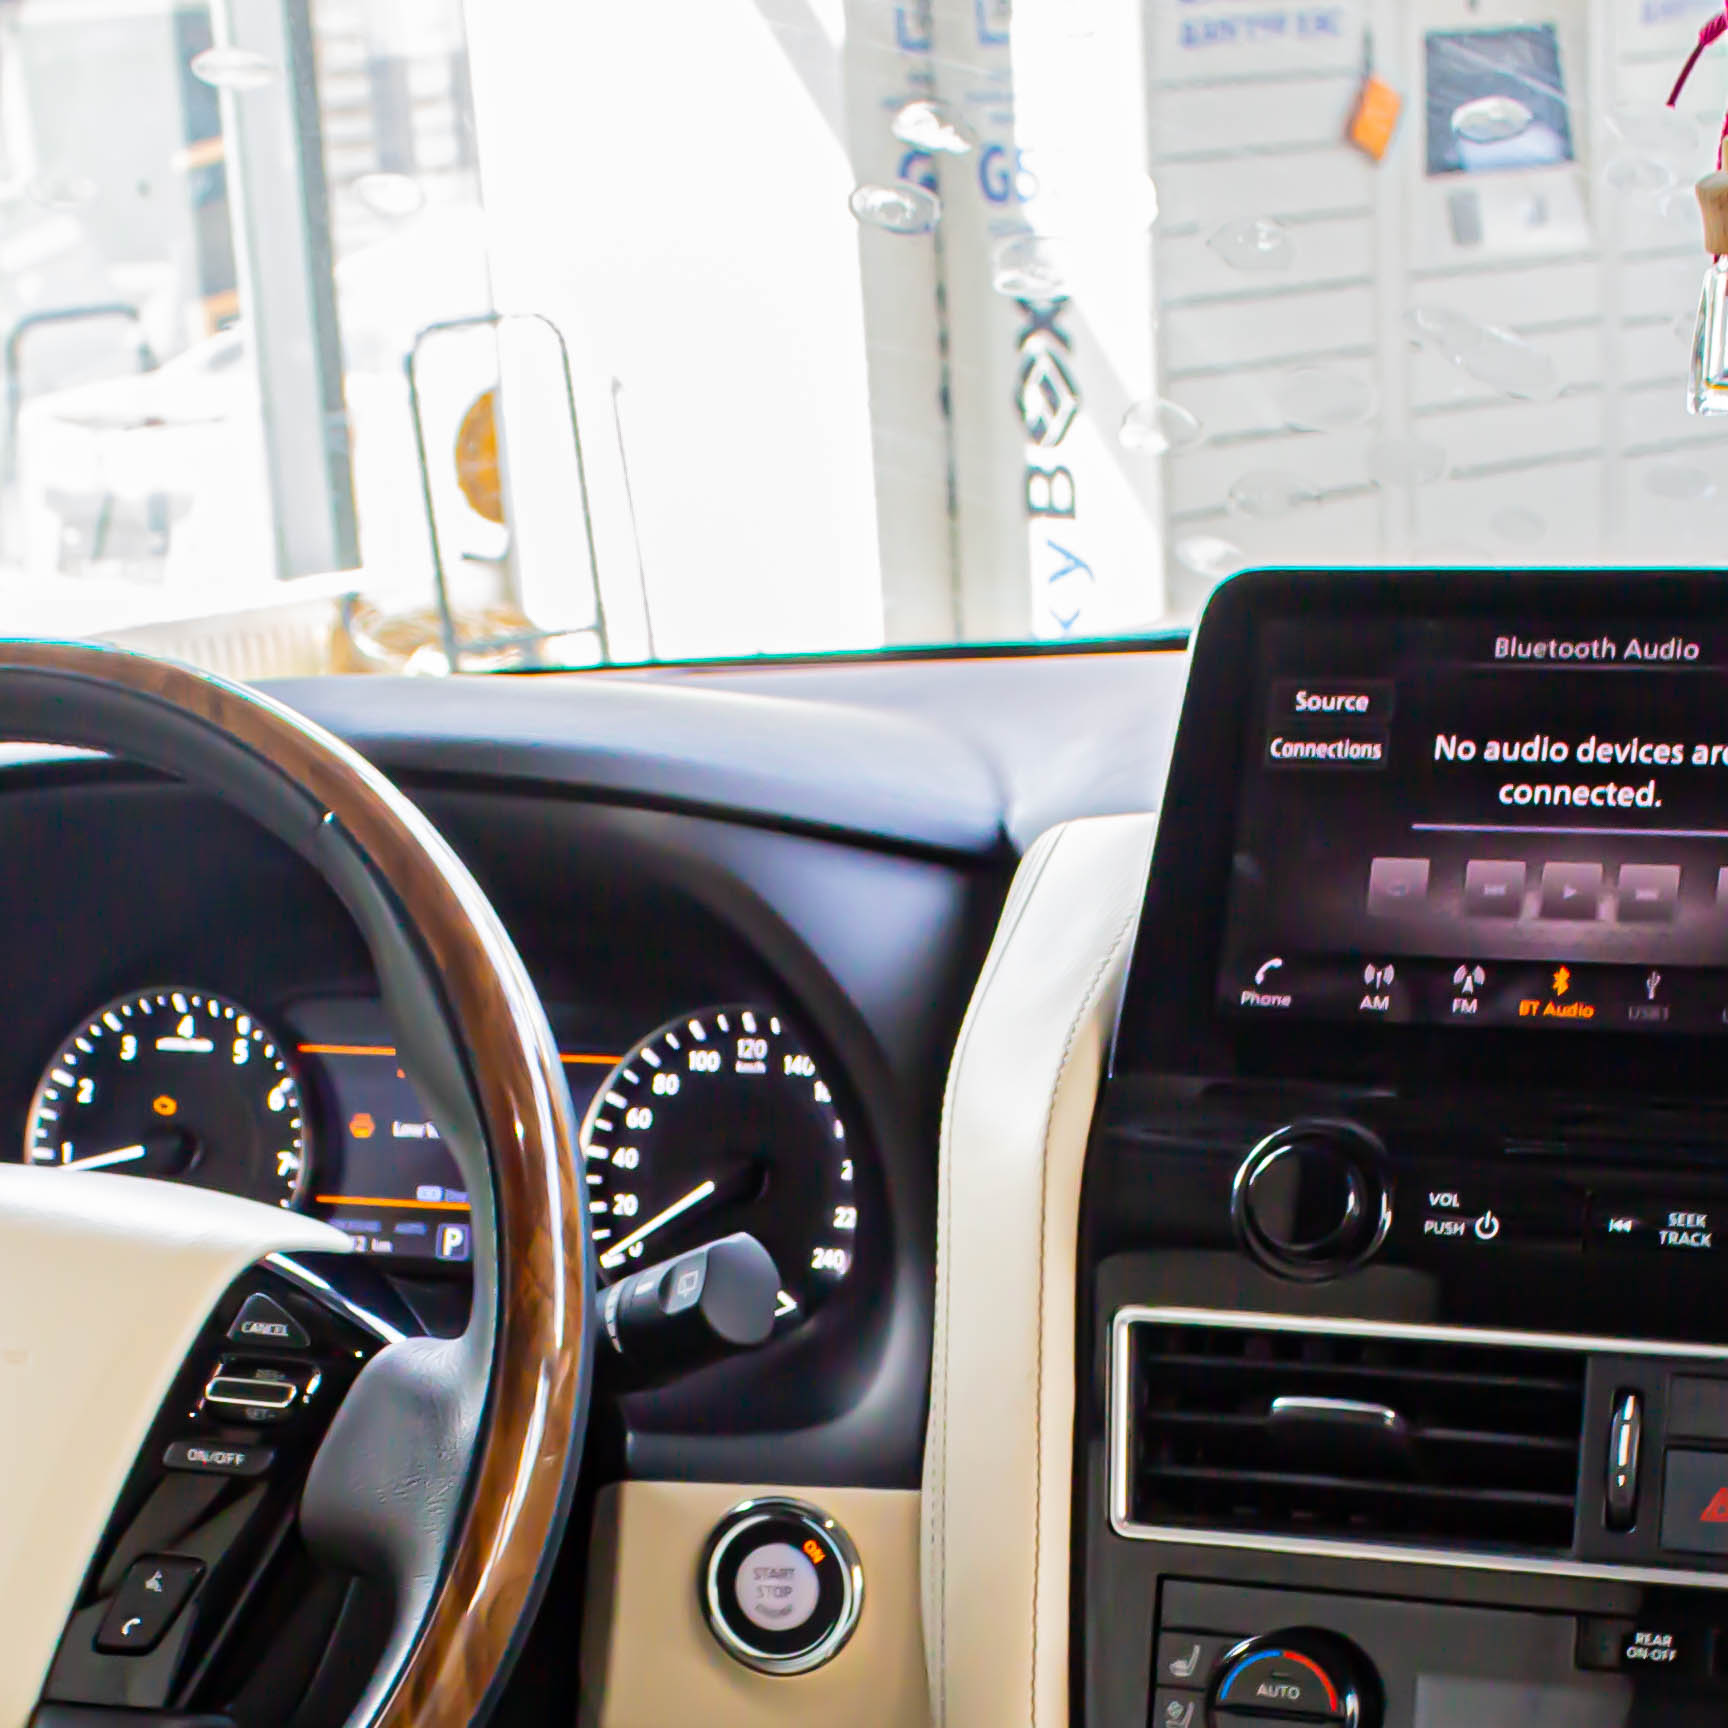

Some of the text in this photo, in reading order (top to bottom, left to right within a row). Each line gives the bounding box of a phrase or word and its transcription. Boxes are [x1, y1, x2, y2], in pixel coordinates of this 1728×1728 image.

[1494, 636, 1700, 662] Bluetooth Audio
[1295, 690, 1369, 712] Source
[1270, 737, 1383, 761] Connections
[1434, 734, 1476, 762] No
[1483, 735, 1569, 764] audio
[1576, 735, 1684, 765] devices
[1498, 780, 1662, 808] connected.
[1240, 990, 1292, 1009] Phone
[1359, 994, 1390, 1011] AM
[1452, 997, 1478, 1014] FM
[1519, 999, 1595, 1019] BT Audio
[177, 1014, 195, 1039] 4
[120, 1033, 138, 1062] 3
[232, 1037, 250, 1064] 5
[736, 1037, 768, 1060] 120
[688, 1049, 721, 1073] 100
[783, 1054, 816, 1077] 140
[76, 1077, 94, 1104] 2
[651, 1073, 680, 1096] 80
[267, 1086, 286, 1112] 6
[625, 1107, 654, 1130] 60
[611, 1147, 640, 1170] 40
[612, 1193, 639, 1217] 20
[1428, 1191, 1460, 1208] VOL
[1424, 1219, 1466, 1237] PUSH
[1668, 1211, 1708, 1228] SEEK
[442, 1226, 464, 1257] P
[1658, 1229, 1713, 1249] TRACK
[811, 1247, 849, 1274] 240
[240, 1320, 289, 1338] CANCEL
[802, 1539, 827, 1566] ON
[756, 1584, 793, 1599] STOP
[1635, 1632, 1673, 1648] REAR
[1256, 1682, 1301, 1700] AUTO
